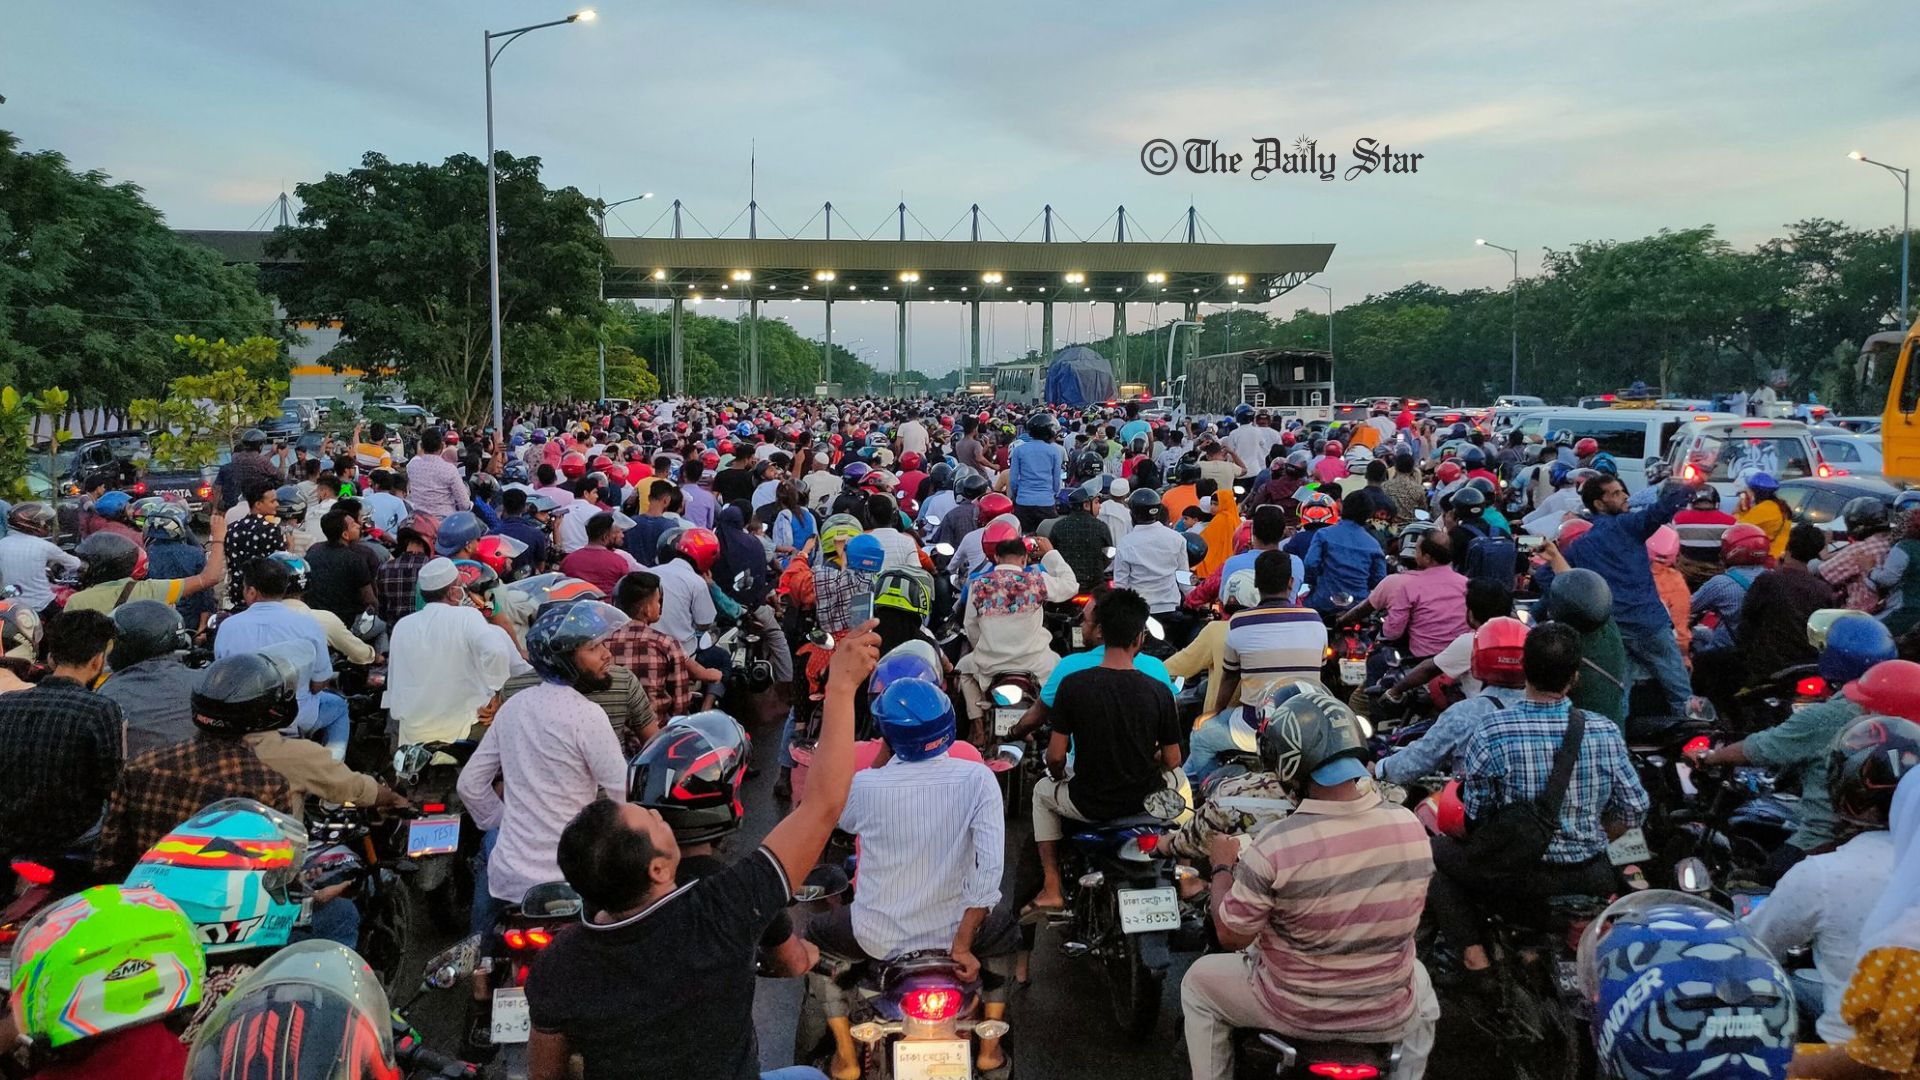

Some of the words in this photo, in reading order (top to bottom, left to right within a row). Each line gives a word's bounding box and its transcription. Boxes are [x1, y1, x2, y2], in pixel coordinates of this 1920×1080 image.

[412, 834, 428, 850] ON
[433, 823, 455, 841] TEST
[111, 960, 148, 977] SMK
